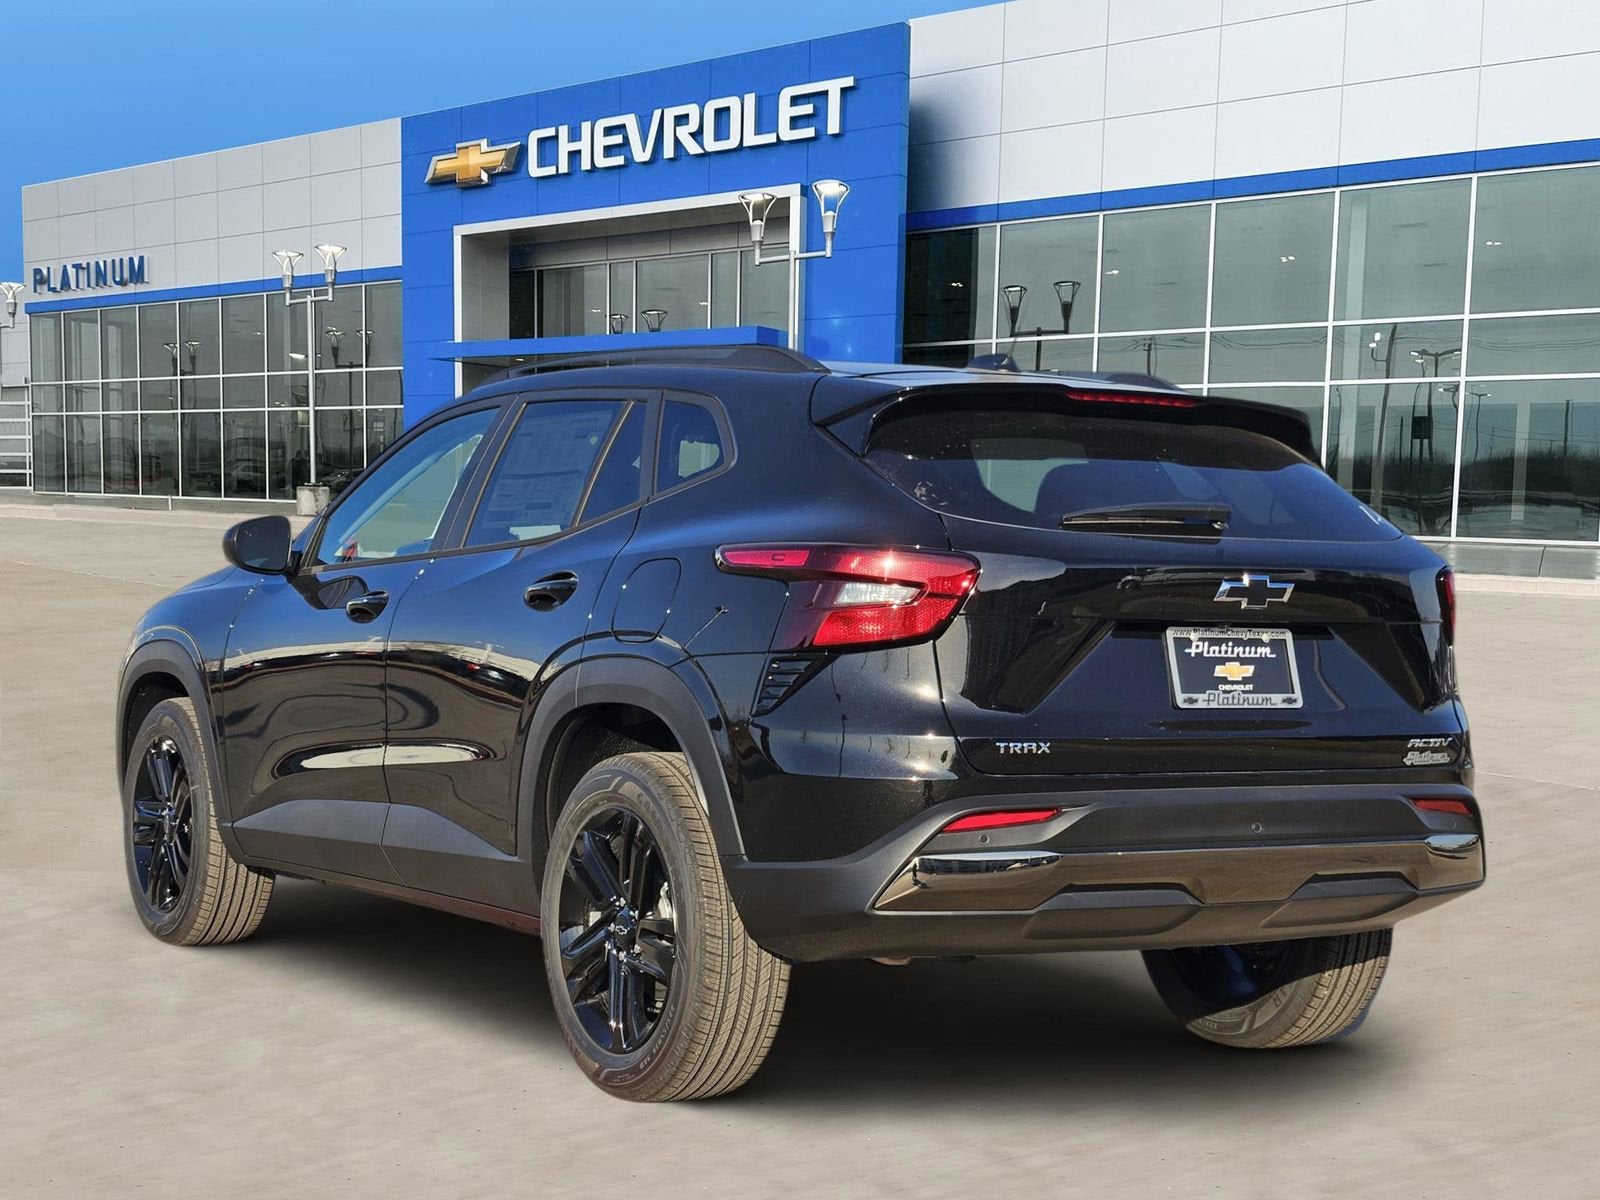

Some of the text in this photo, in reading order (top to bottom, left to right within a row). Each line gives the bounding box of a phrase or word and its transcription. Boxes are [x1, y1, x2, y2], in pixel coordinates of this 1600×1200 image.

[527, 75, 856, 178] CHEVROLET
[33, 255, 149, 294] PLATINUM
[1172, 628, 1287, 638] wwwPlatinumChevyTexa.com
[1184, 641, 1277, 658] Platinum
[1202, 692, 1278, 706] Platinum
[995, 742, 1051, 754] TRAX
[1407, 737, 1454, 748] ACTIV
